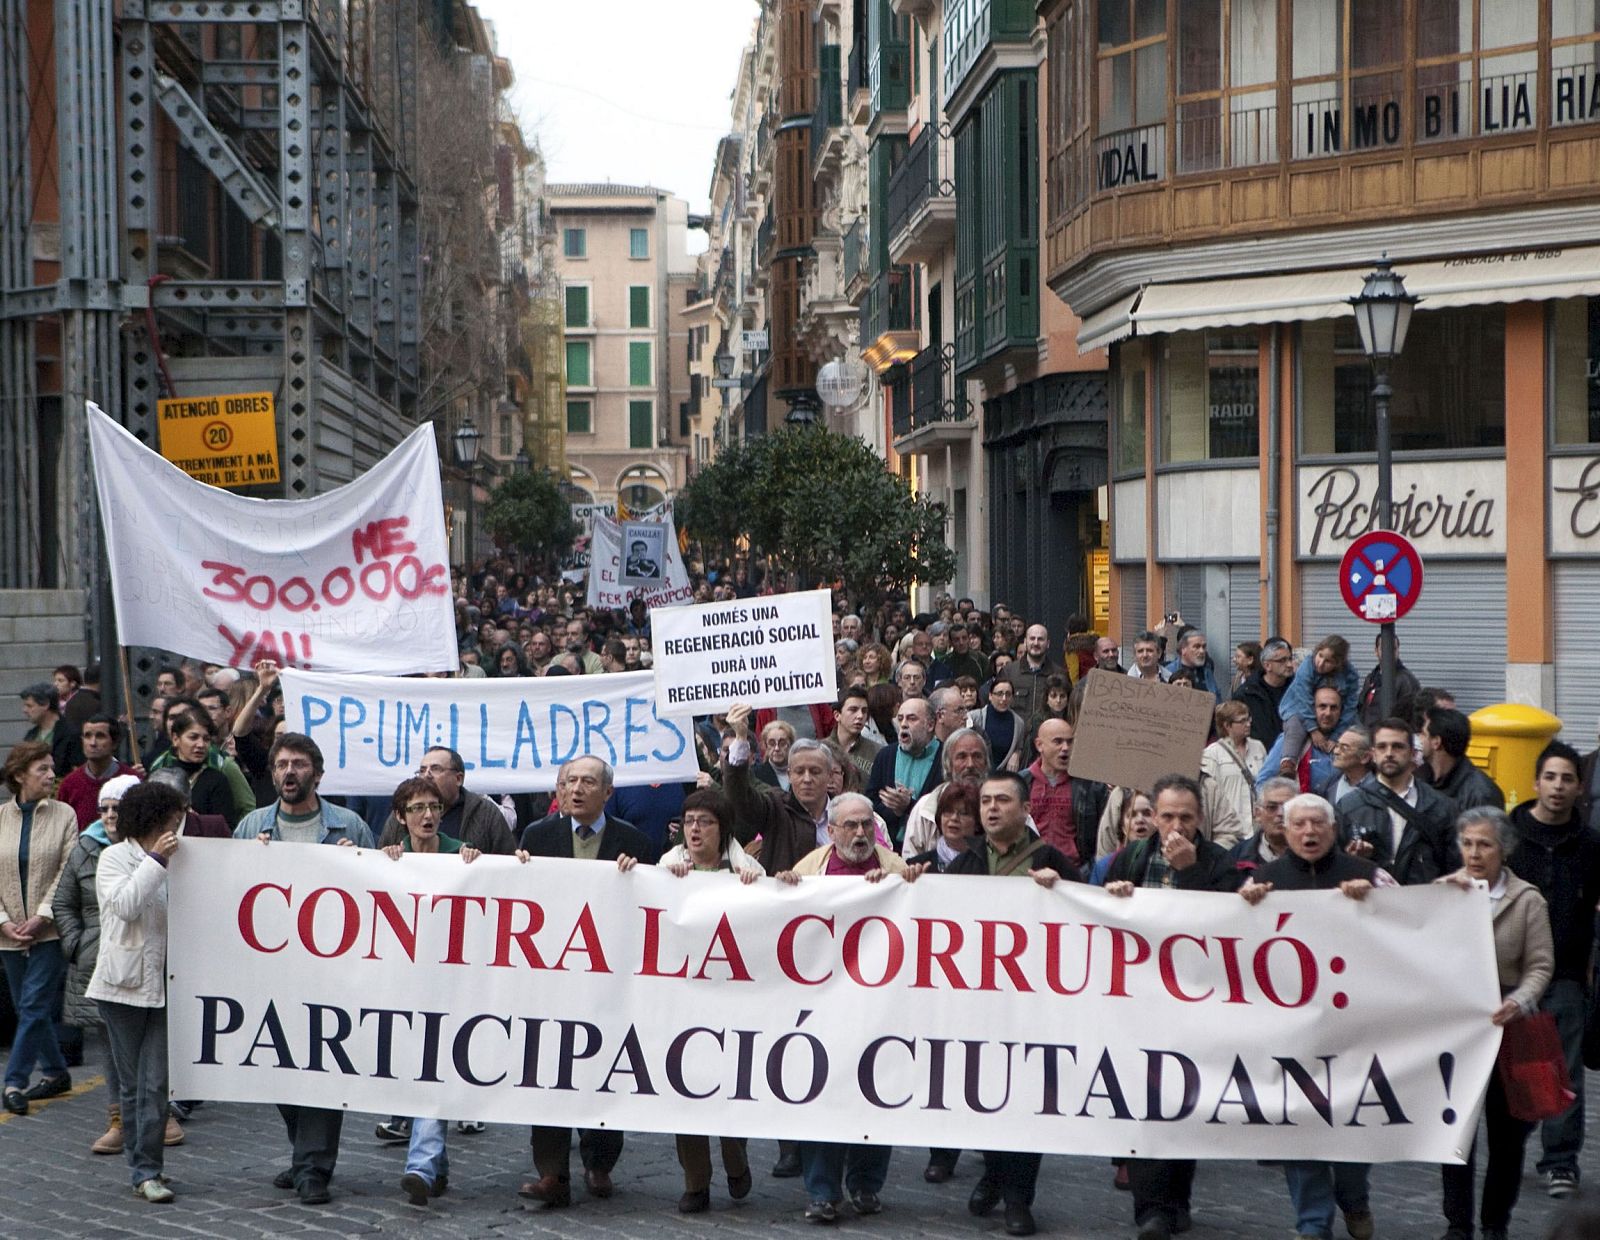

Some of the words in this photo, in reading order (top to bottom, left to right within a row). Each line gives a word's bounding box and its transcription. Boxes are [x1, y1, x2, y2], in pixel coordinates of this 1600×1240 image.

[164, 397, 220, 420] ATENCIÓ
[225, 397, 269, 415] OBRES
[1210, 403, 1254, 418] RADO
[209, 428, 227, 445] 20
[247, 455, 254, 467] A
[225, 472, 238, 484] DE
[242, 470, 255, 482] LA
[259, 468, 277, 481] VIA
[702, 606, 748, 627] NOMÉS
[752, 606, 779, 621] UNA
[664, 625, 764, 656] REGENERACIÓ
[769, 623, 820, 644] SOCIAL
[711, 654, 747, 675] DURÀ
[750, 655, 777, 670] UNA
[668, 674, 760, 703] REGENERACIÓ
[765, 671, 824, 692] POLÍTICA
[449, 698, 686, 770] LLADRES
[237, 882, 614, 974] CONTRA
[633, 906, 755, 982] LA
[776, 912, 1350, 1010] CORRUPCIÓ:
[192, 994, 829, 1105] PARTICIPACIÓ
